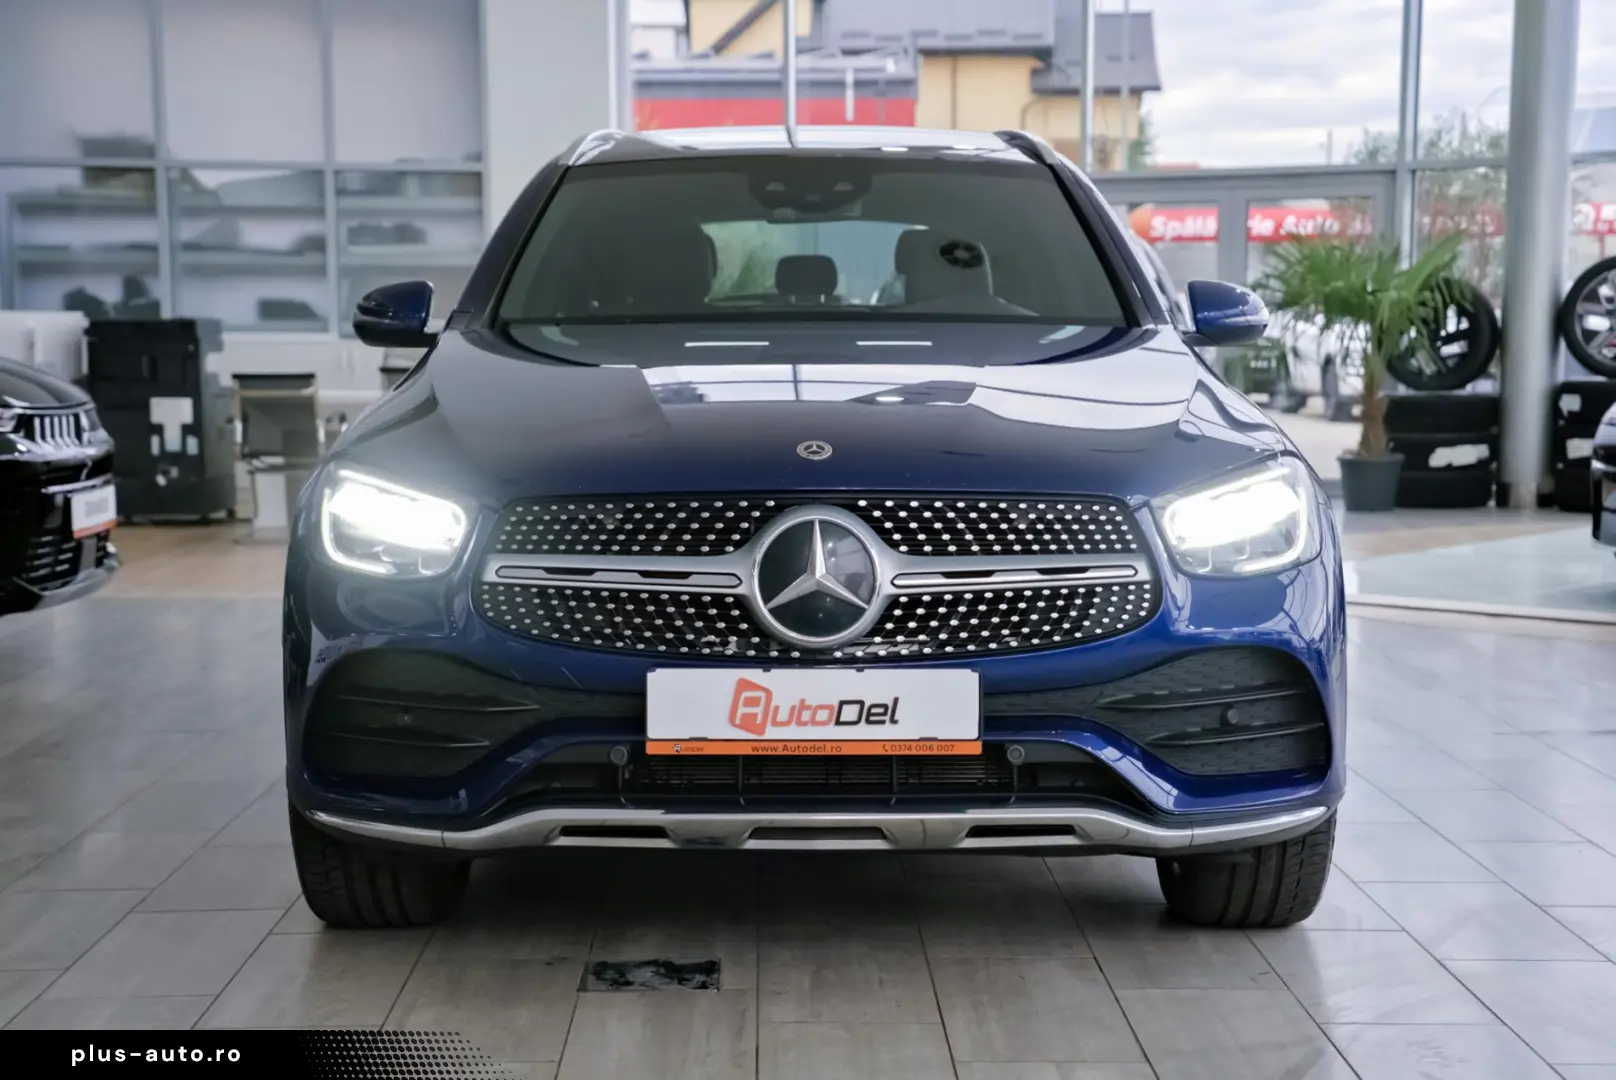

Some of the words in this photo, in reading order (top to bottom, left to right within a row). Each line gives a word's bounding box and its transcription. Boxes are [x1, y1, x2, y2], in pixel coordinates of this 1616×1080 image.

[728, 679, 900, 735] AutoDel
[751, 743, 842, 754] www.Autodel.ro
[890, 744, 912, 753] 0374
[915, 744, 935, 753] 006
[937, 744, 955, 753] 007
